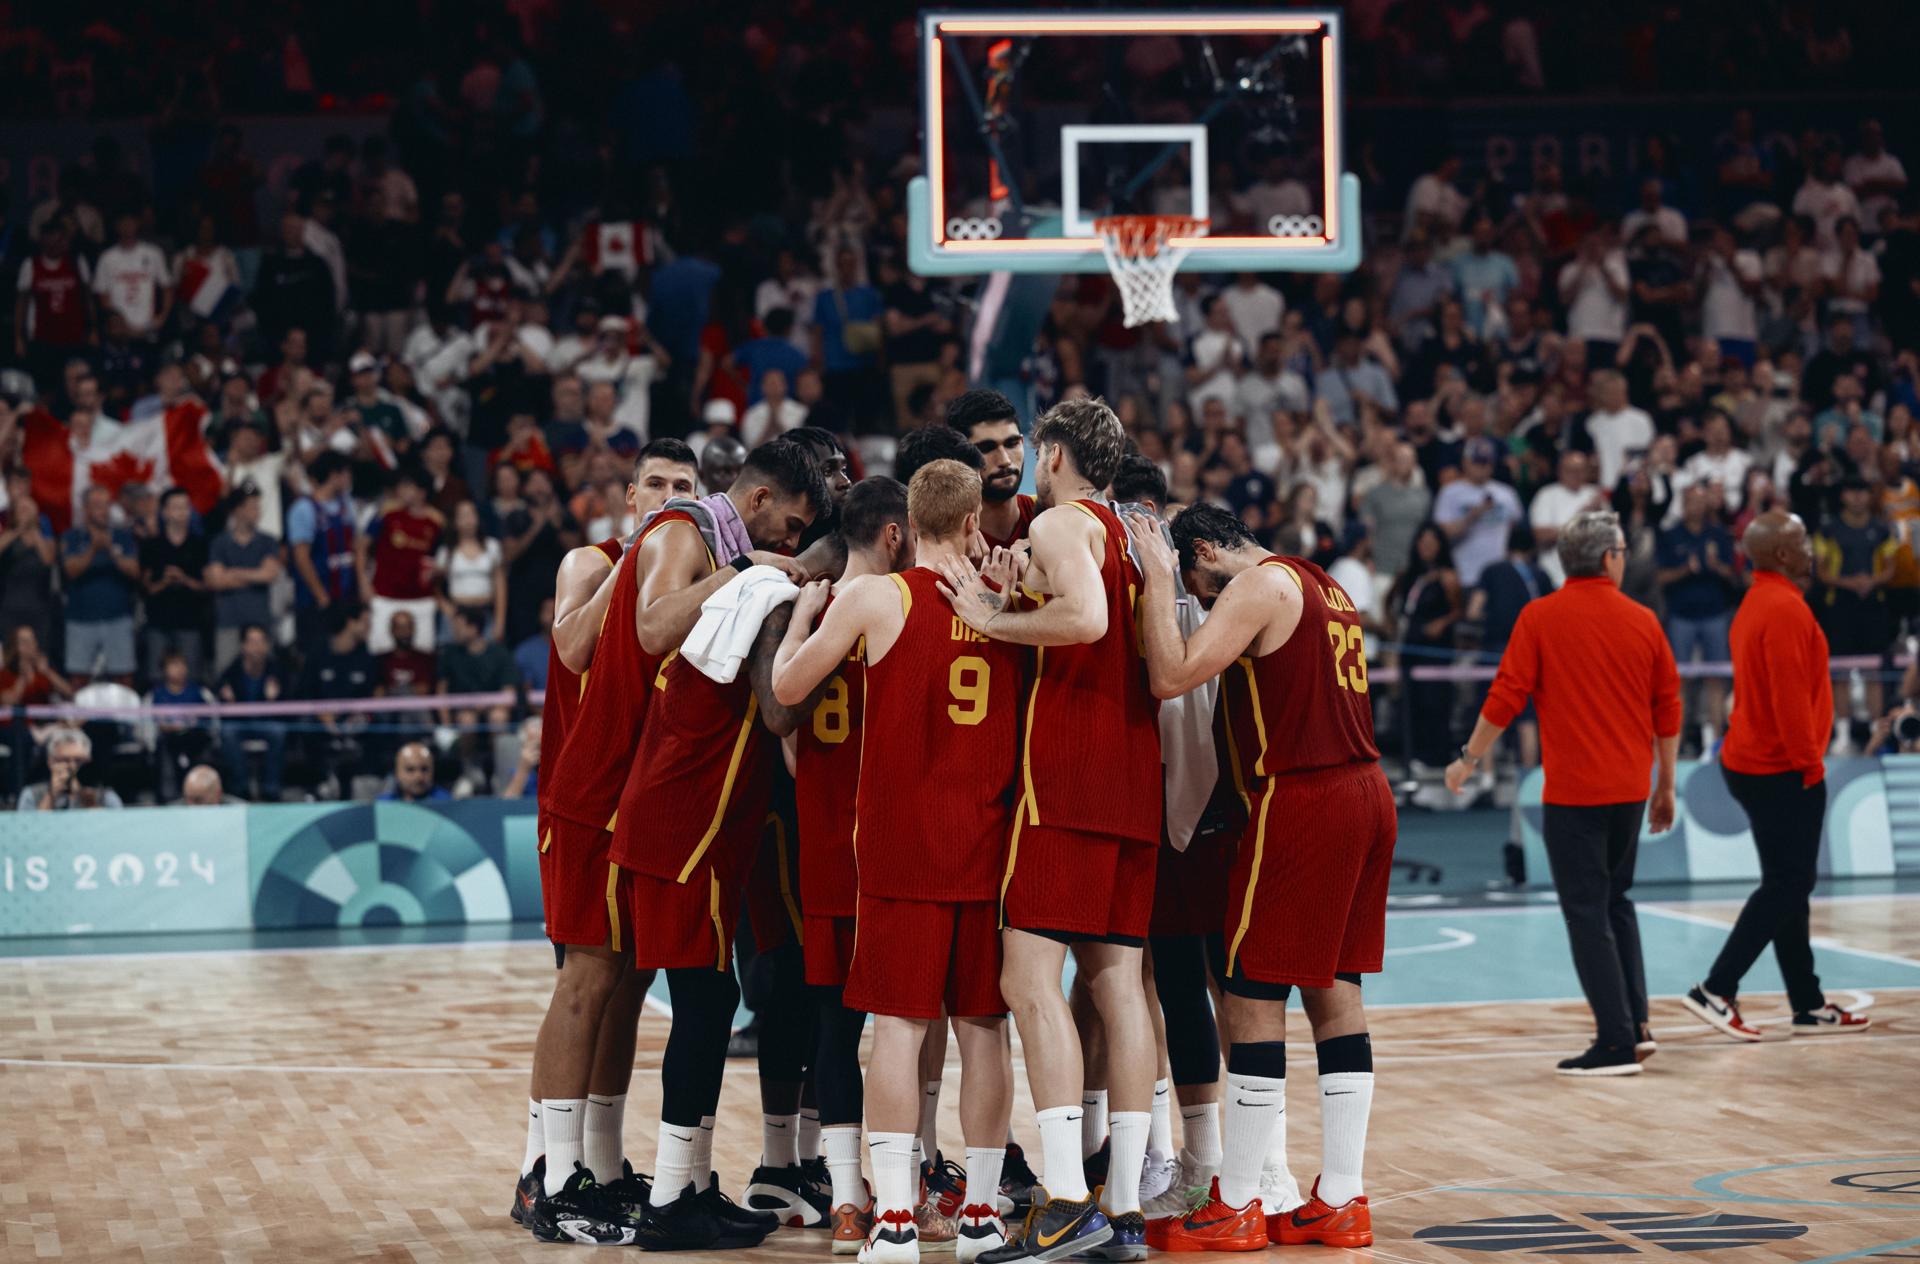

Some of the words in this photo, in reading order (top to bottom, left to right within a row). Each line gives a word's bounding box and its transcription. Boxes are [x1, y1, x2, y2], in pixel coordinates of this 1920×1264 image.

[947, 655, 991, 726] 9
[1327, 620, 1368, 693] 23
[814, 675, 850, 743] 8
[73, 851, 215, 890] 2024
